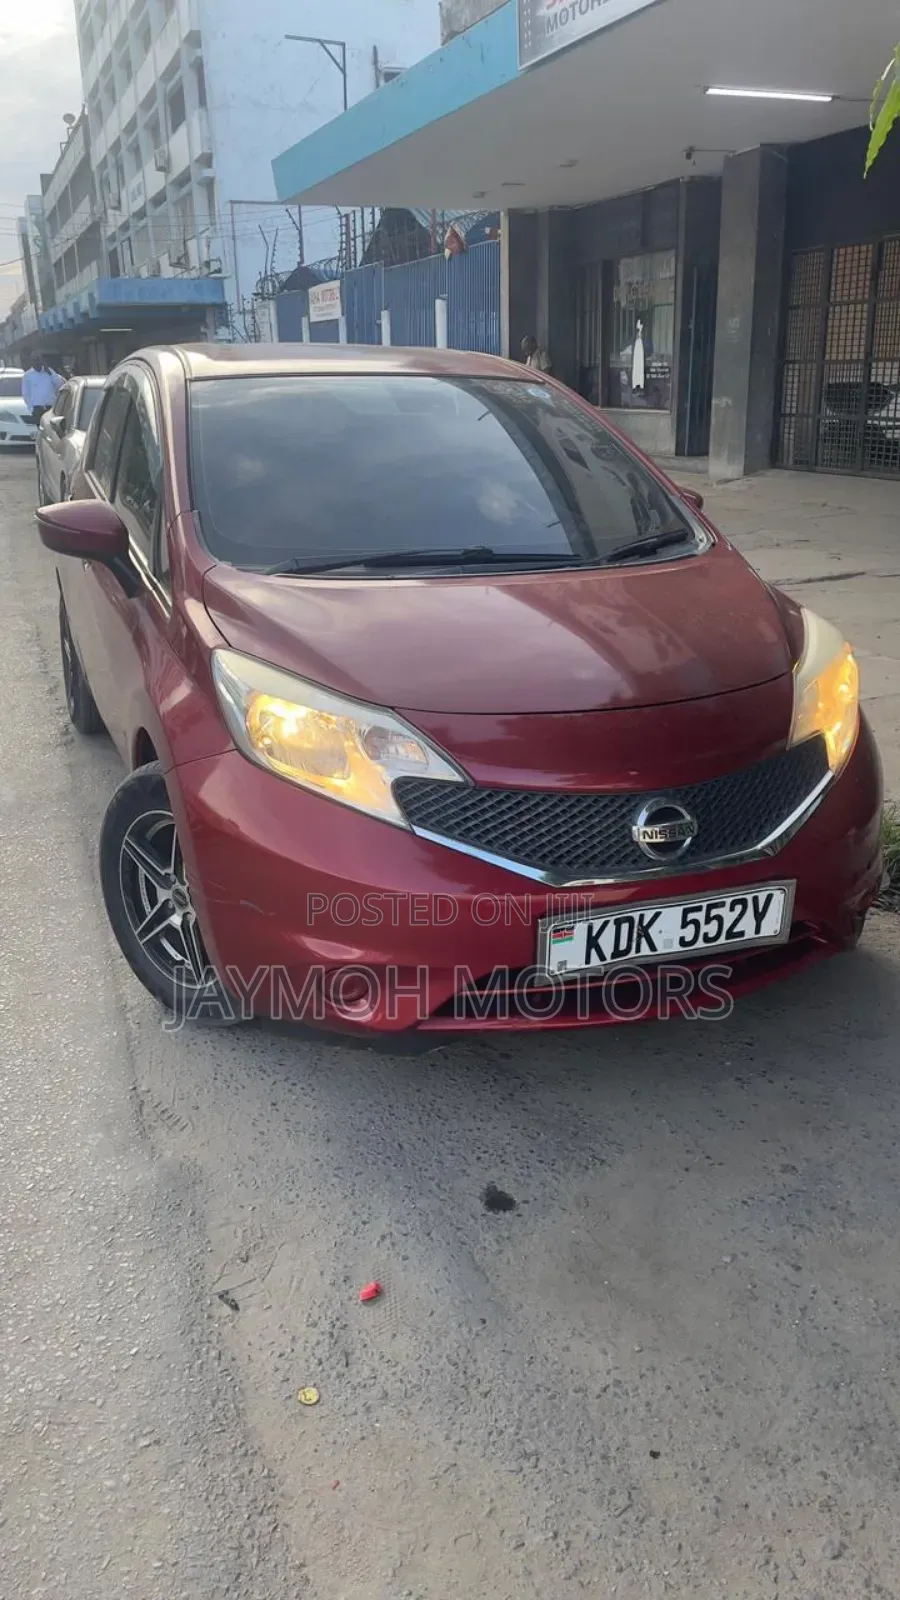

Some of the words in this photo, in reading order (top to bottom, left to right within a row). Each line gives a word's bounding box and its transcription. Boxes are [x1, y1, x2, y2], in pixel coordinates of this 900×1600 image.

[545, 0, 609, 34] MOTO
[642, 821, 694, 840] NISSAN
[584, 911, 663, 965] KDK
[678, 893, 774, 948] 552Y
